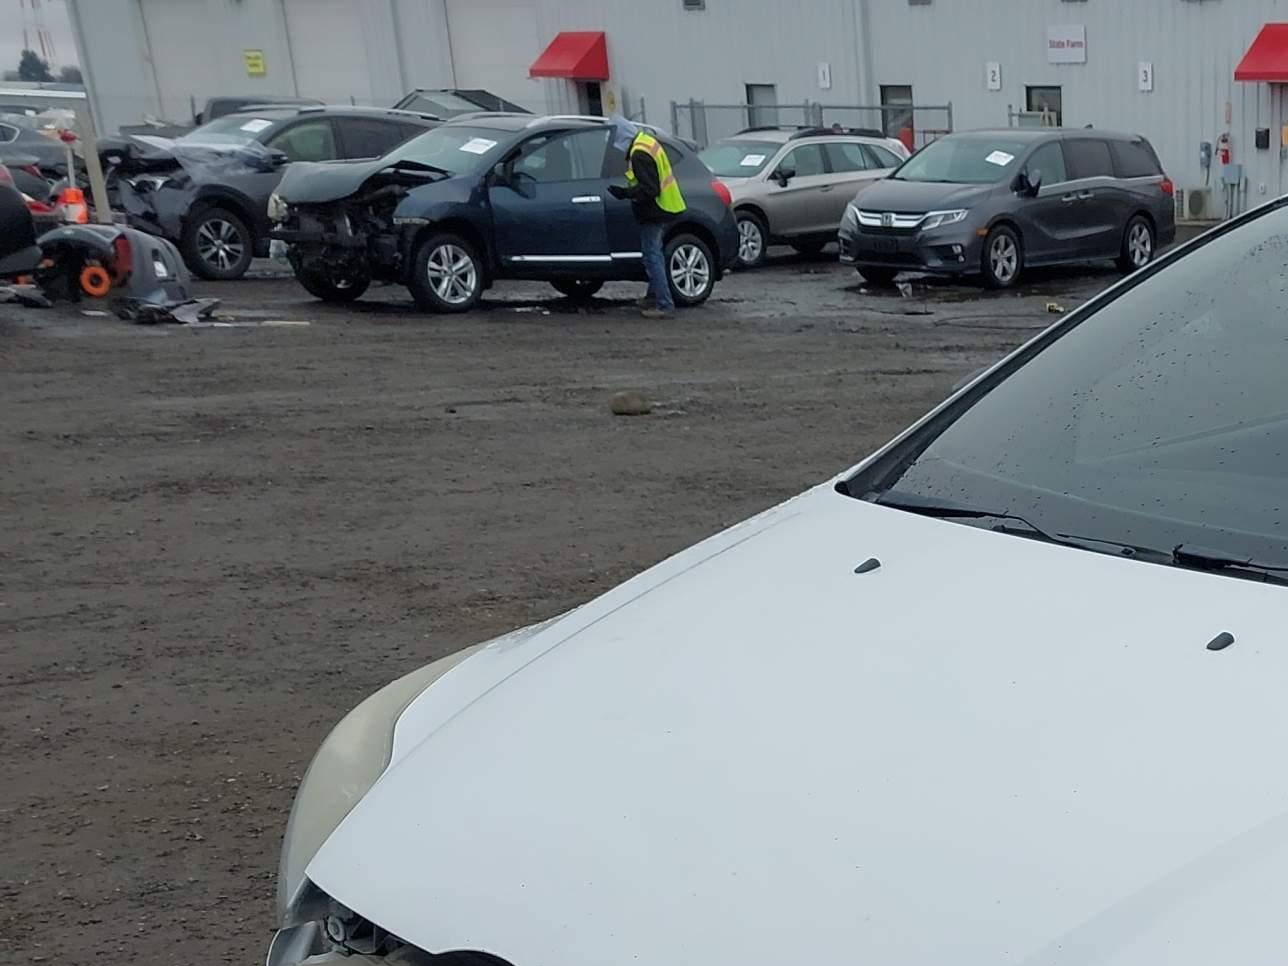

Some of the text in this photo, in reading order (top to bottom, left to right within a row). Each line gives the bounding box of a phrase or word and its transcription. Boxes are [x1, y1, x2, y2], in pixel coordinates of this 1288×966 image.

[1048, 39, 1084, 49] State Farm
[991, 69, 997, 83] 2
[1142, 69, 1149, 83] 3
